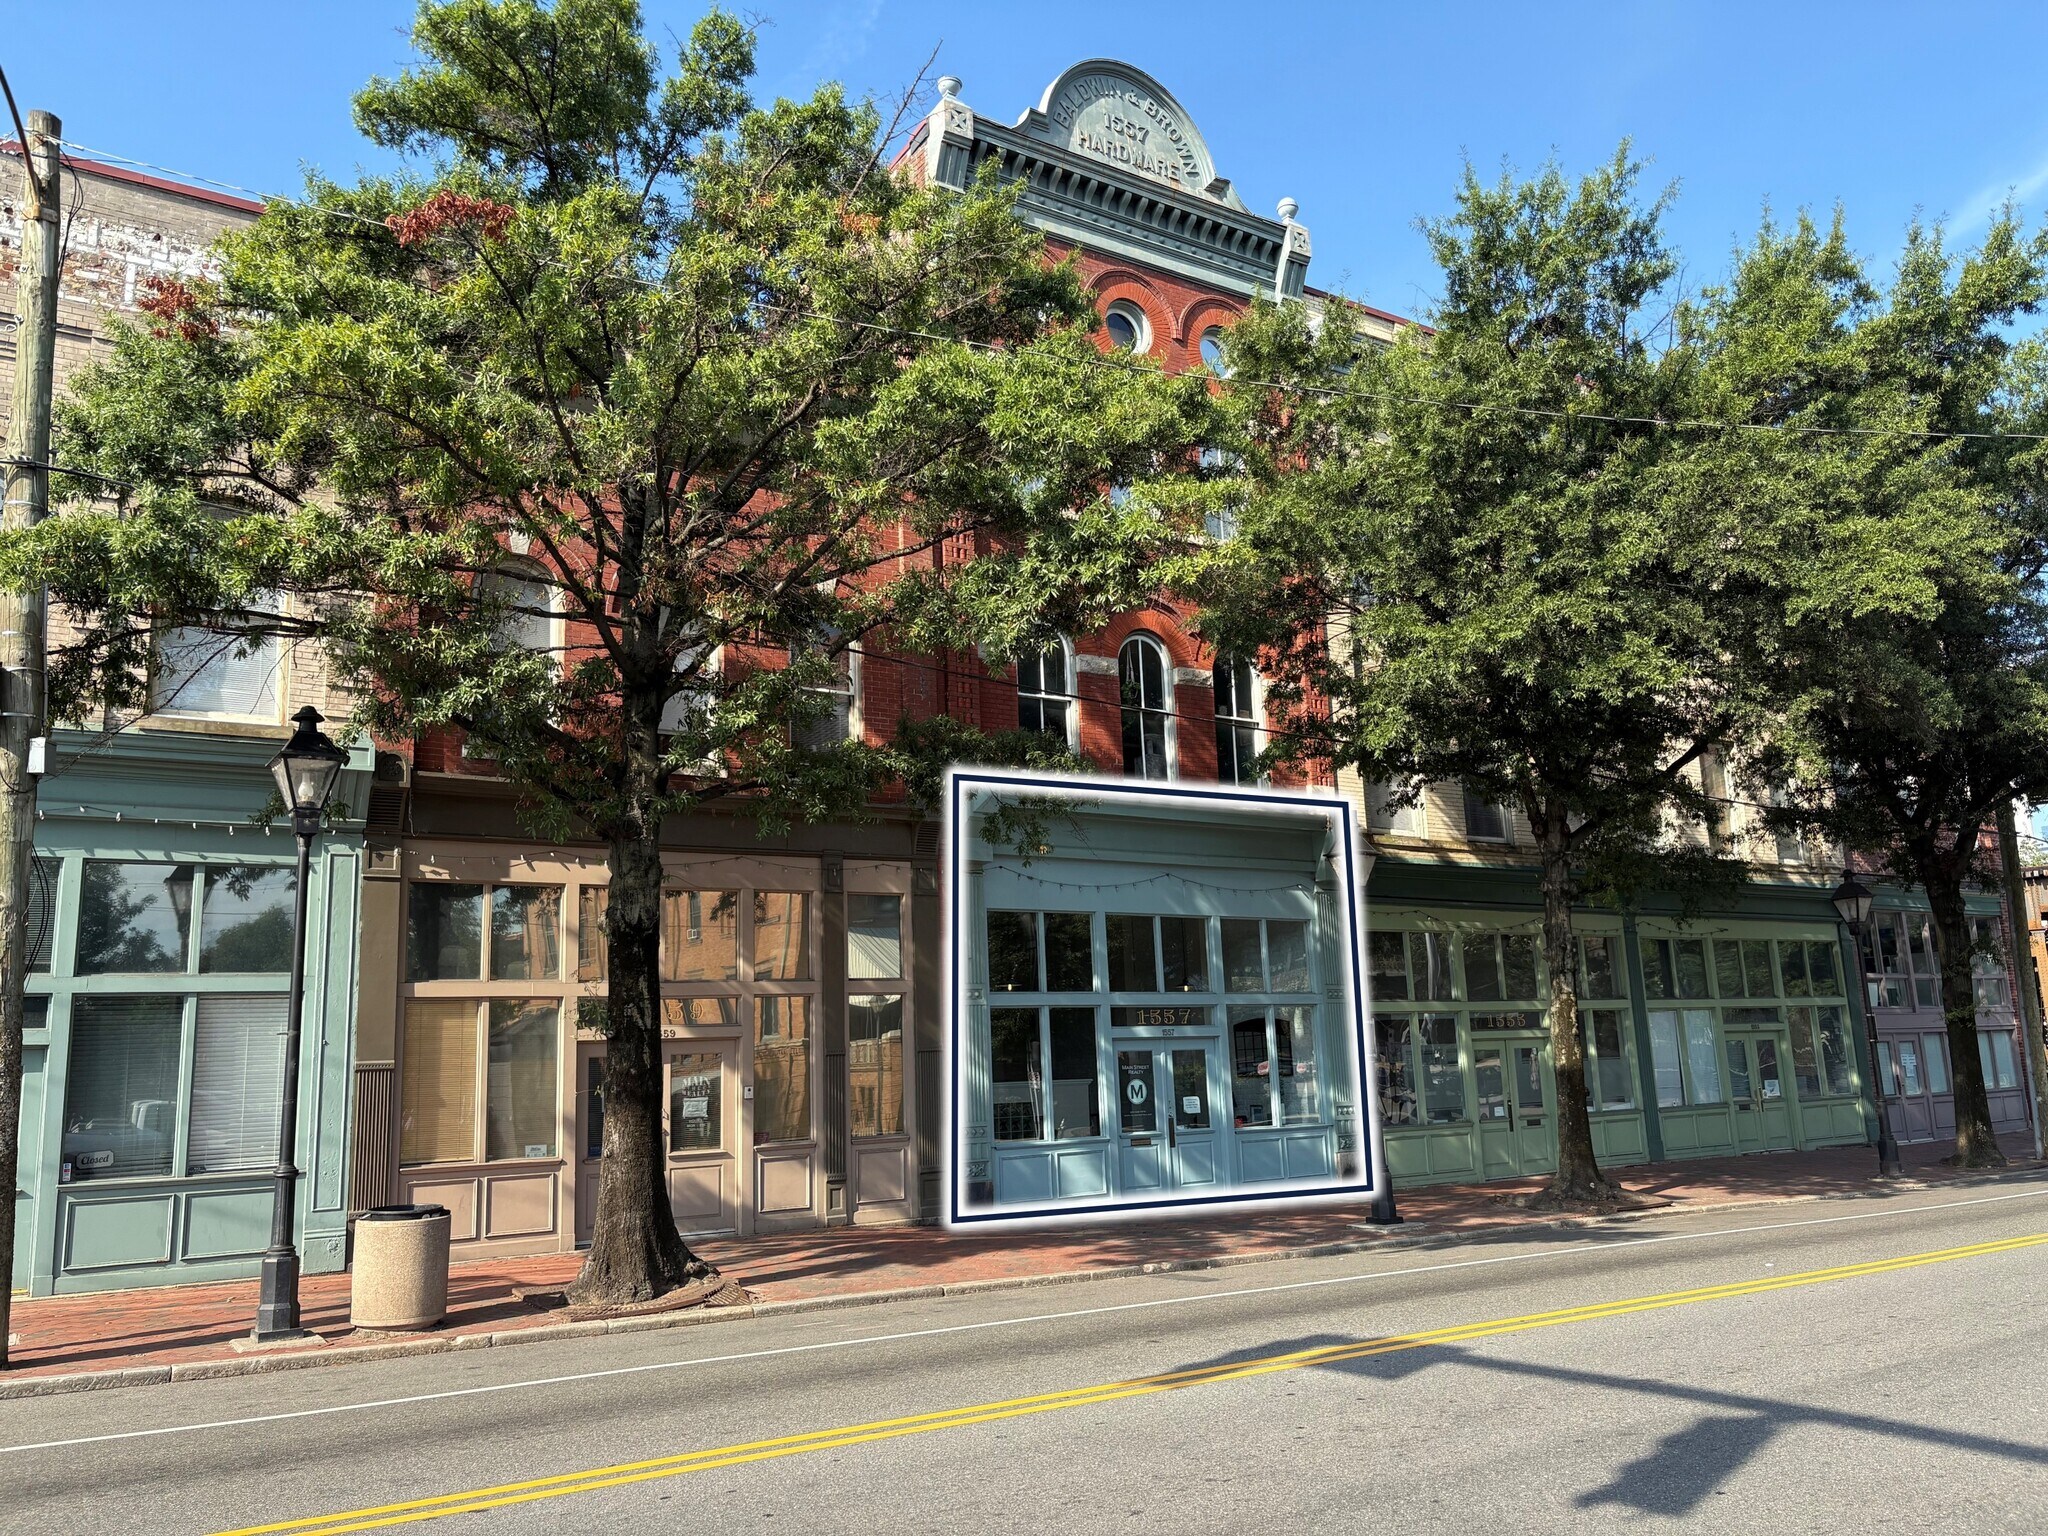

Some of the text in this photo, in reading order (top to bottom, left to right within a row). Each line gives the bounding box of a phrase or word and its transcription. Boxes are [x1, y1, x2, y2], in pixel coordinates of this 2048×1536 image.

[1053, 76, 1199, 178] BALDWIN & BROWN
[1103, 112, 1149, 145] 1557
[1078, 130, 1180, 179] HARDWARE
[1137, 1008, 1191, 1025] 1557
[1131, 1084, 1143, 1099] M
[81, 1154, 109, 1165] Closed
